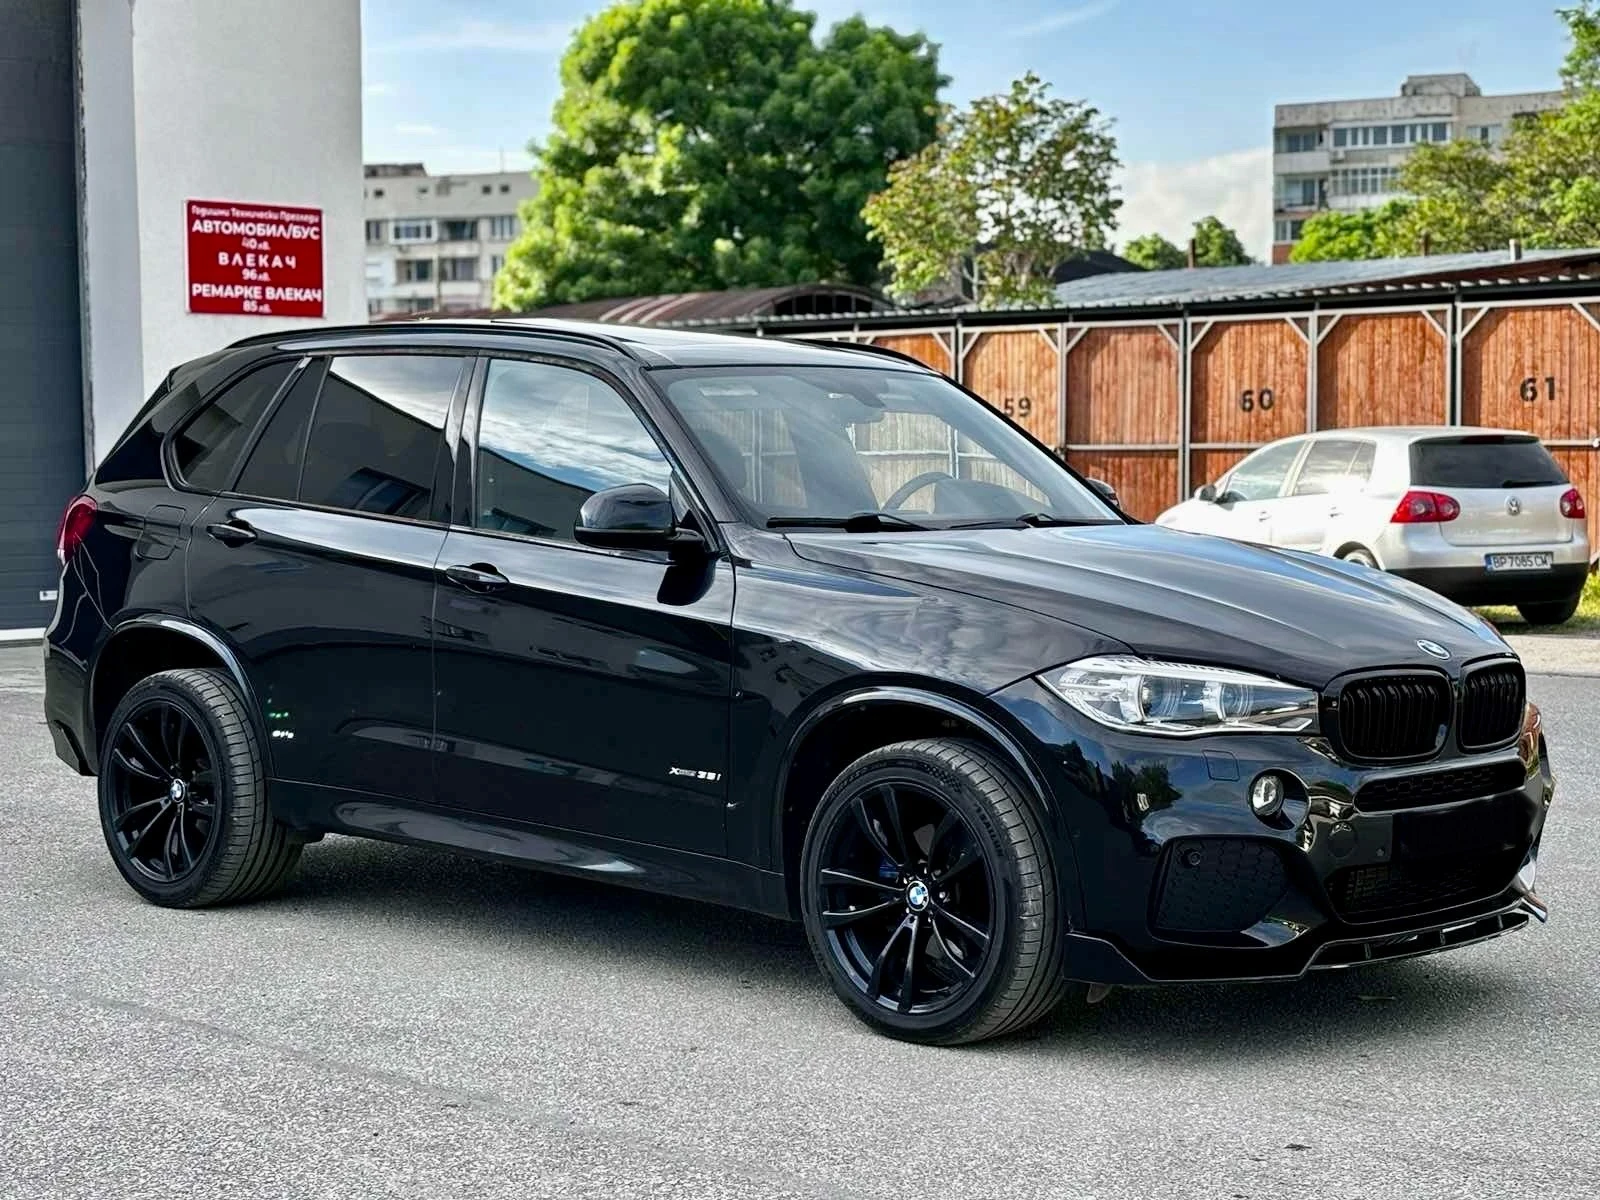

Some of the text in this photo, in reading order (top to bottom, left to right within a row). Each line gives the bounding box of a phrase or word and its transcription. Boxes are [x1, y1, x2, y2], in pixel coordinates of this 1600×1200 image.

[191, 219, 321, 240] АВТОМОБИЛ/БУС
[242, 268, 257, 280] 96
[191, 283, 322, 303] РЕМАРКЕ ВЛЕКАЧ
[1520, 376, 1555, 402] 61
[1004, 397, 1032, 418] 59
[1242, 389, 1274, 412] 60
